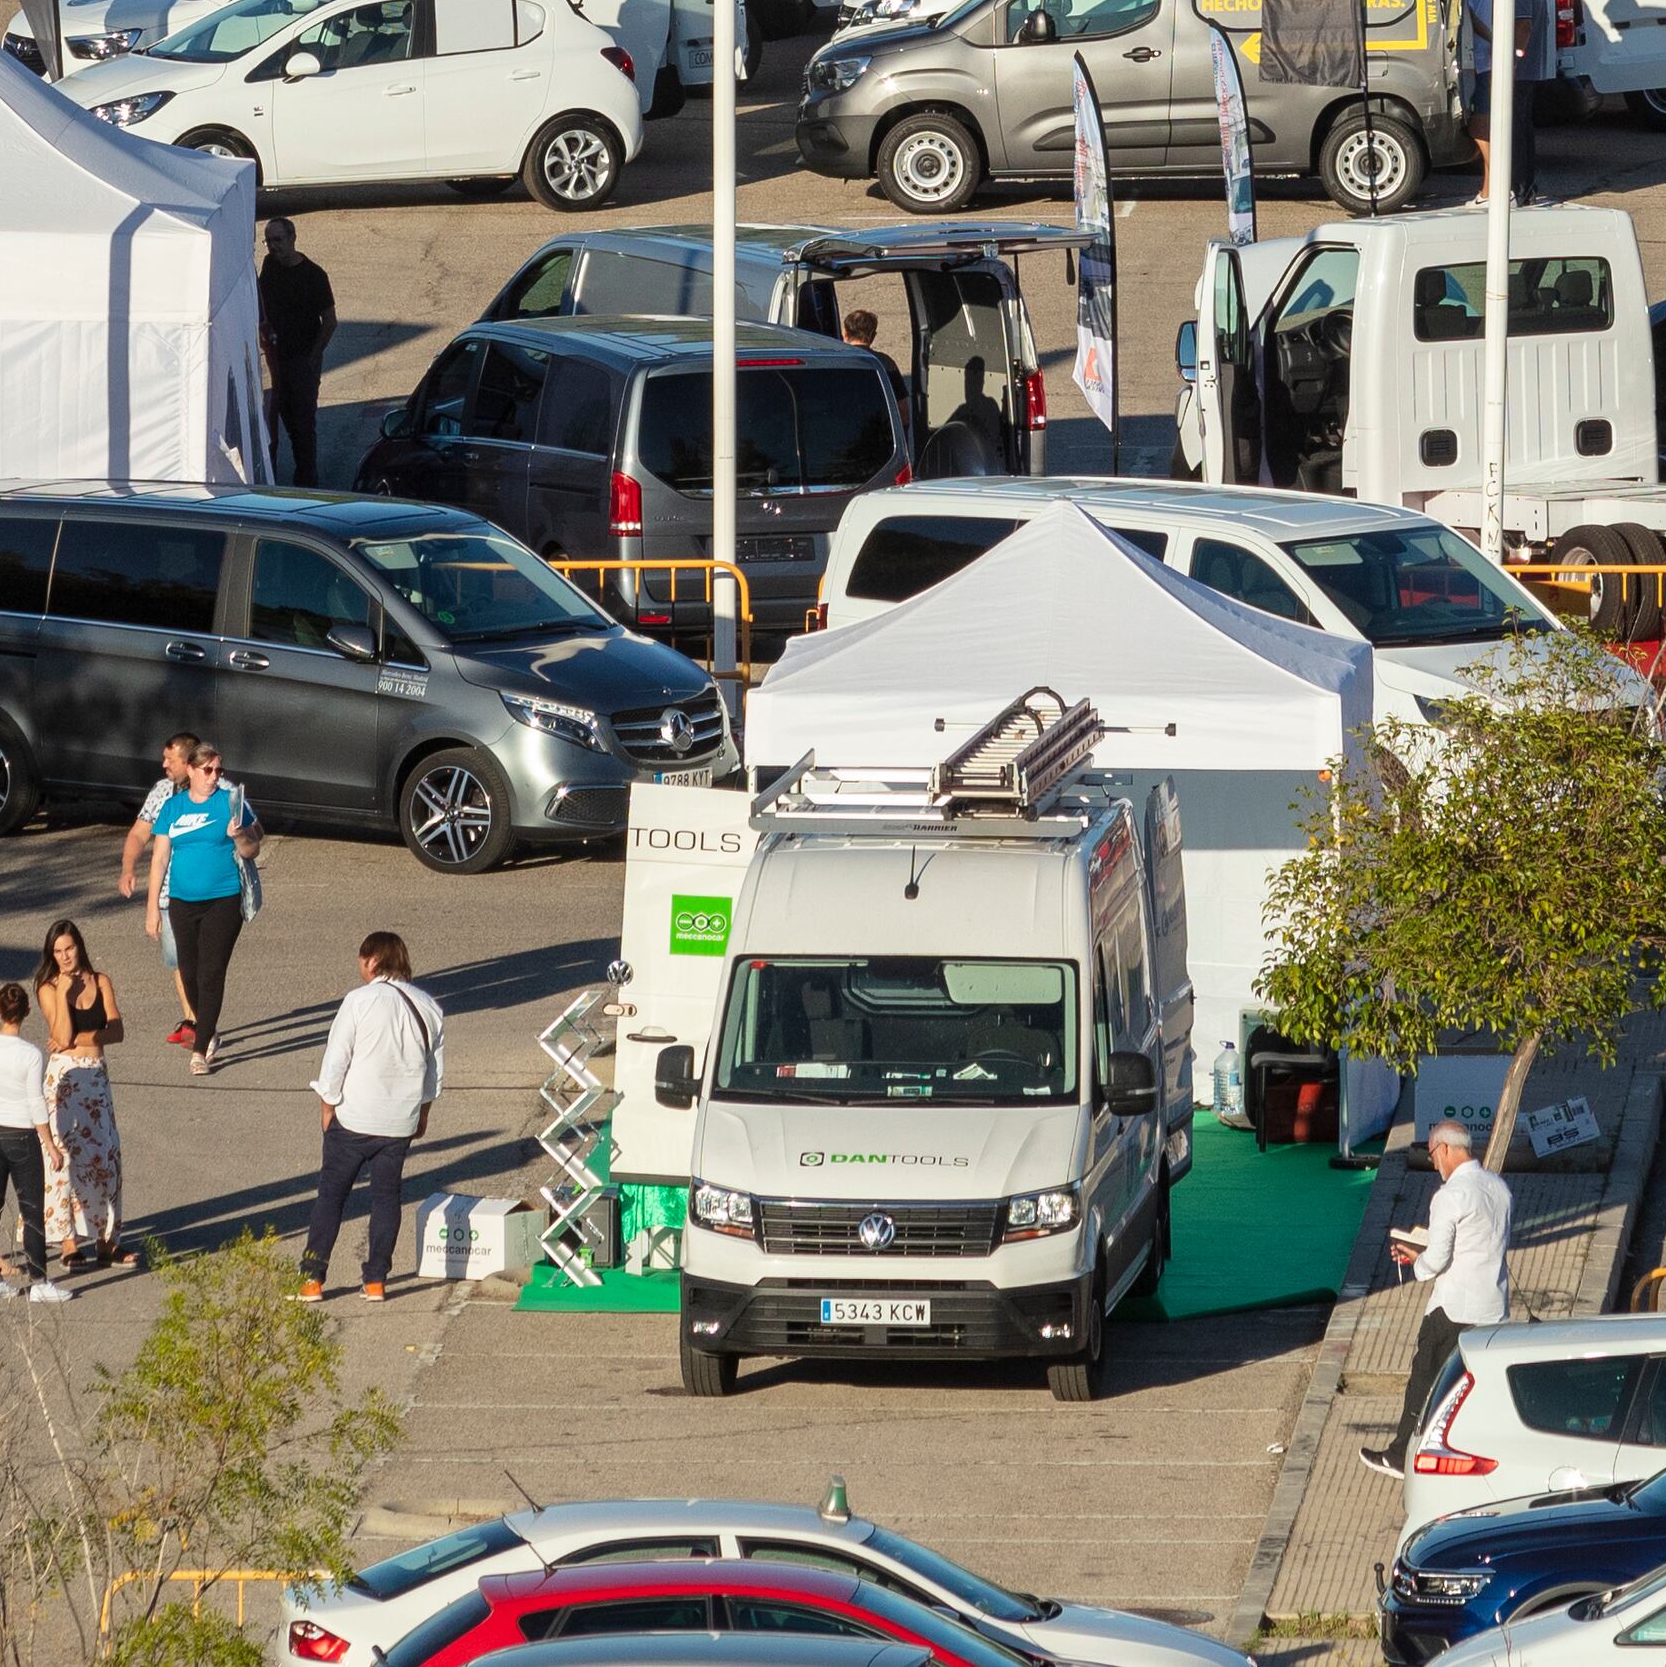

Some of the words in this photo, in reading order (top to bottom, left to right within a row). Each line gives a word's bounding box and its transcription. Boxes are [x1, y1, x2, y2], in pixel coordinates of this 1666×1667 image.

[1426, 4, 1437, 24] MM
[378, 680, 393, 692] 900
[394, 683, 404, 694] 14
[405, 684, 426, 696] 2004
[663, 772, 690, 787] 9788
[692, 770, 709, 786] KYT
[175, 813, 210, 826] NIKE
[629, 827, 741, 853] TOOLS
[676, 932, 725, 942] meccanocar
[831, 1153, 969, 1168] DANTOOLS
[426, 1244, 492, 1256] meccanocar
[833, 1303, 882, 1321] 5343
[889, 1303, 926, 1321] KCW
